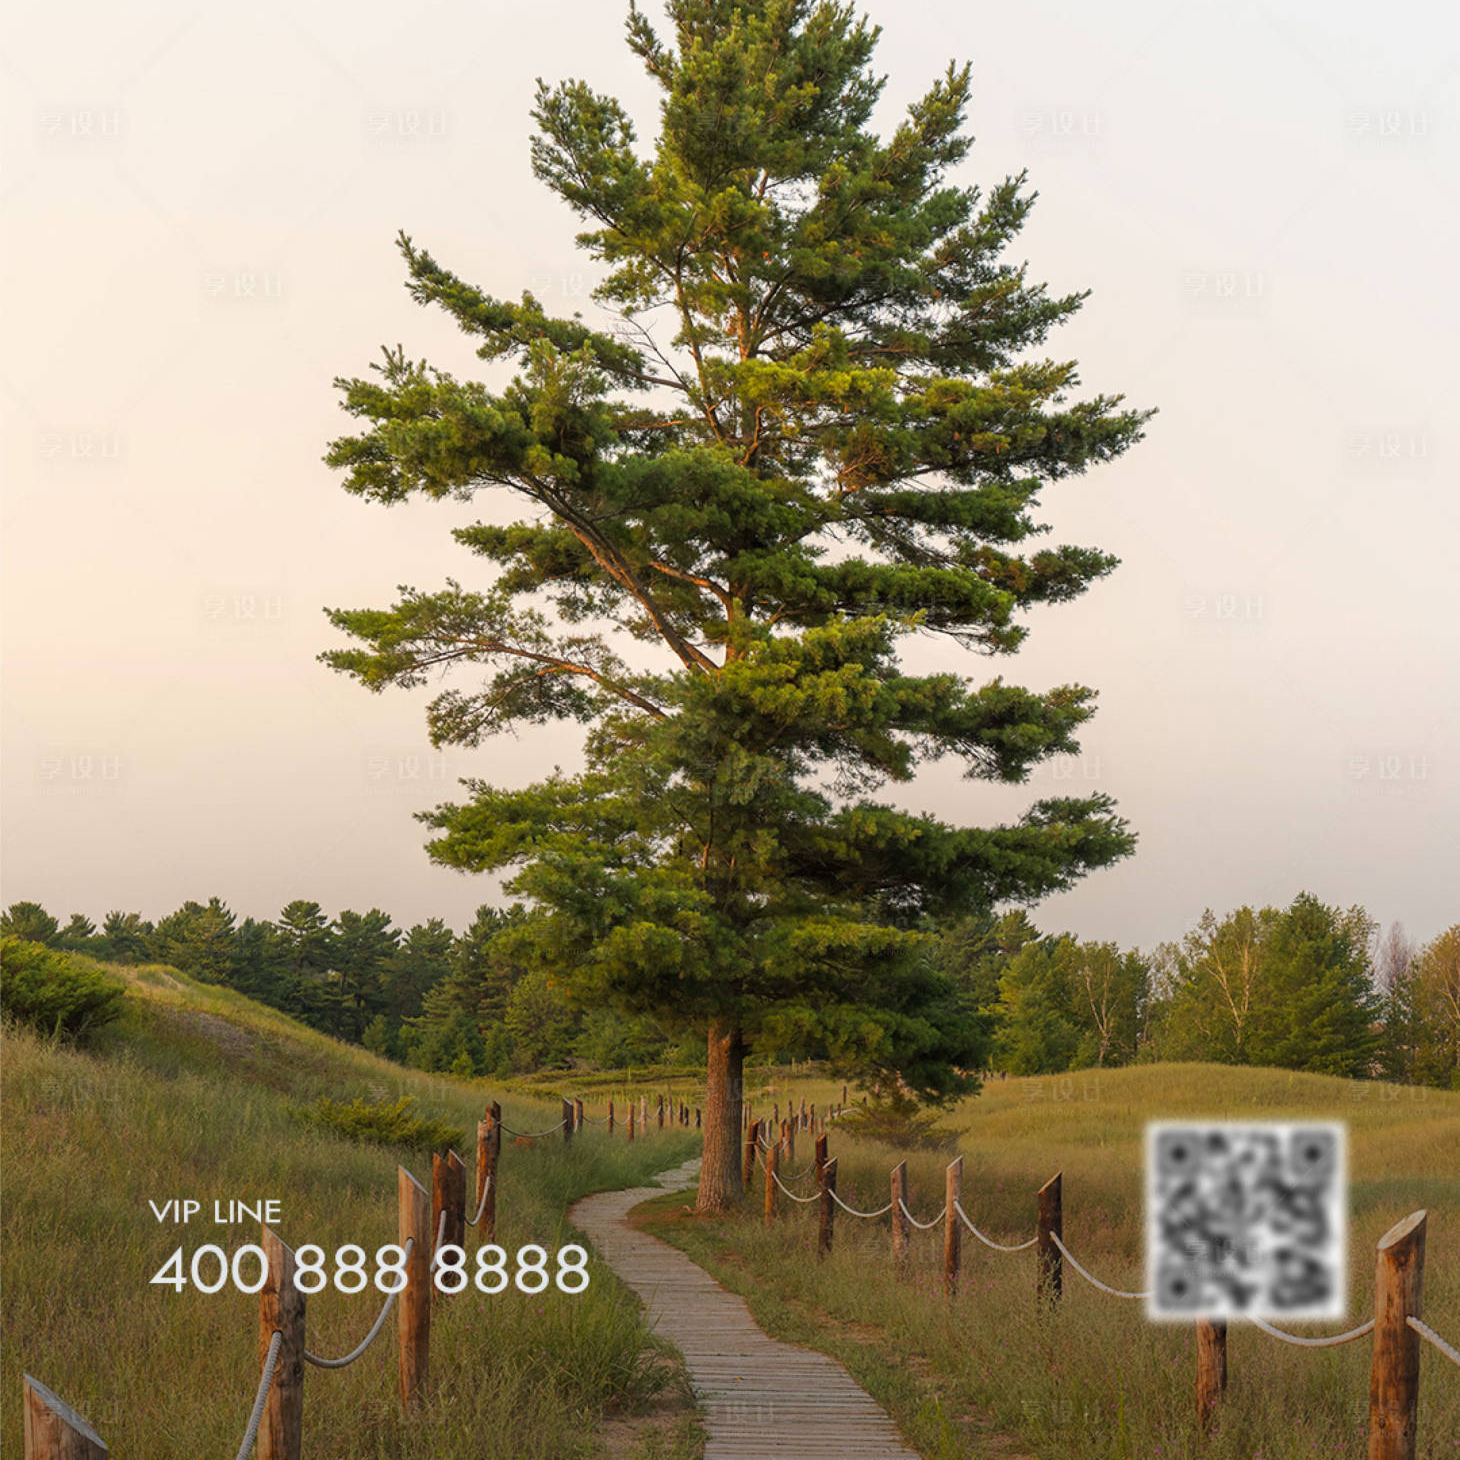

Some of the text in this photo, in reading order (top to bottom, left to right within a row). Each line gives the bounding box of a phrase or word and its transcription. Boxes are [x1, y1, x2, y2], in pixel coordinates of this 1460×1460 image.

[148, 1199, 281, 1224] VIP LINE
[149, 1243, 590, 1295] 400 888 8888
